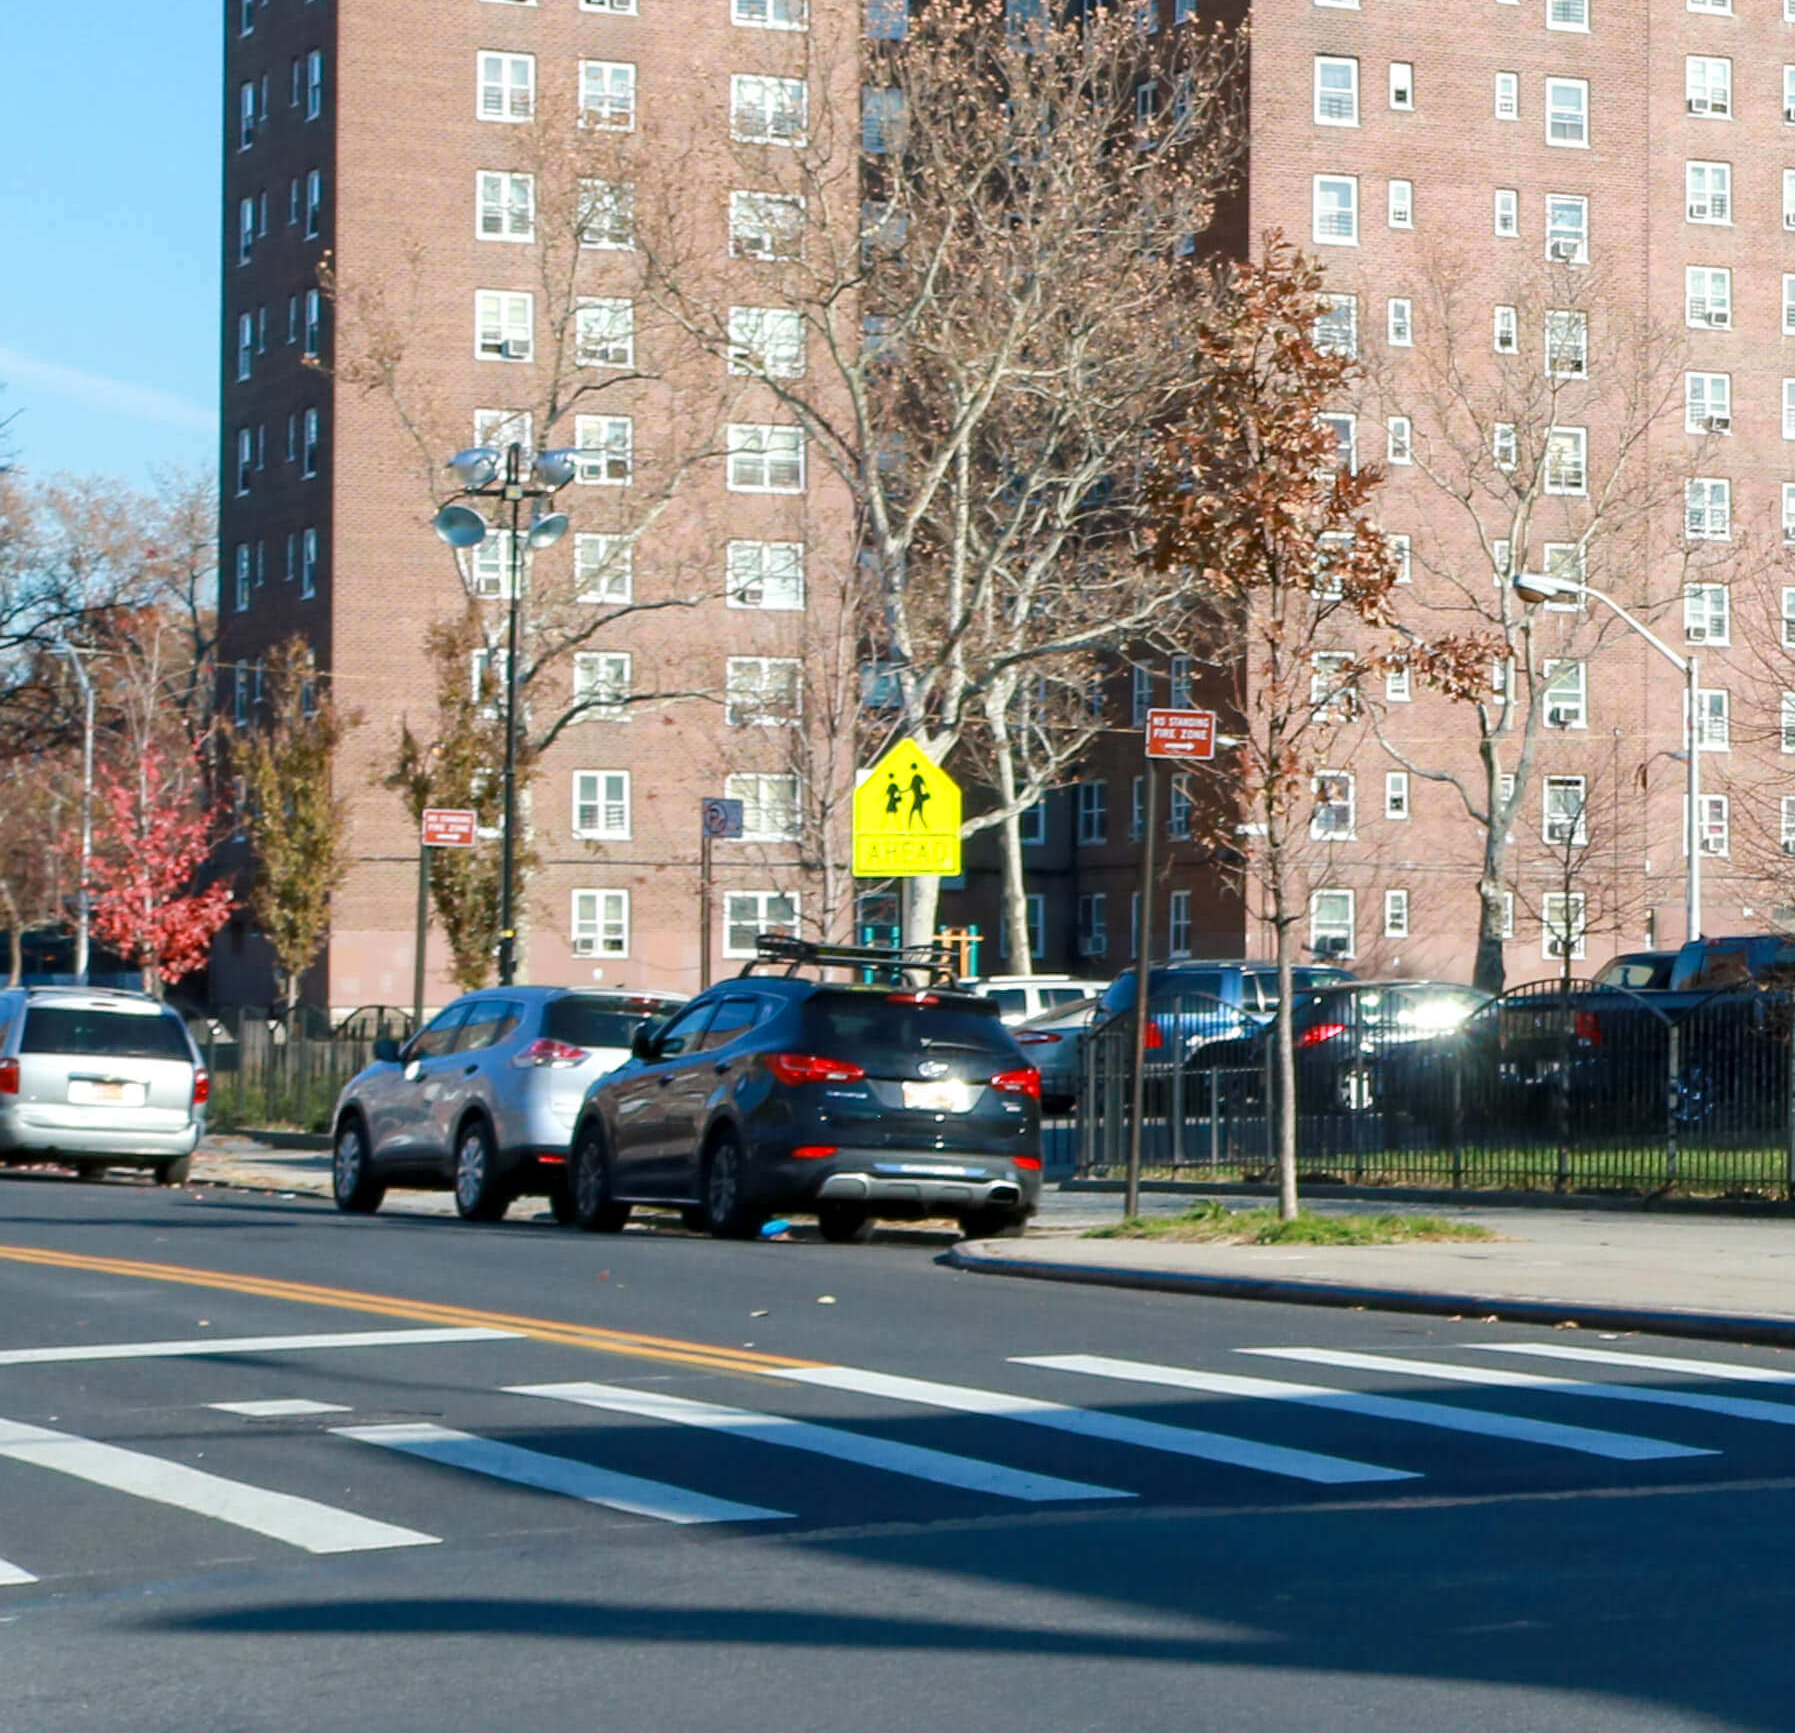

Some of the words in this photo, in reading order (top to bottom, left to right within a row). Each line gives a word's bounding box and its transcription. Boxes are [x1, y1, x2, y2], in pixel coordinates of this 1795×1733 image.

[1153, 728, 1176, 739] FIRE
[1180, 729, 1208, 740] ZONE
[868, 841, 948, 862] AHEAD
